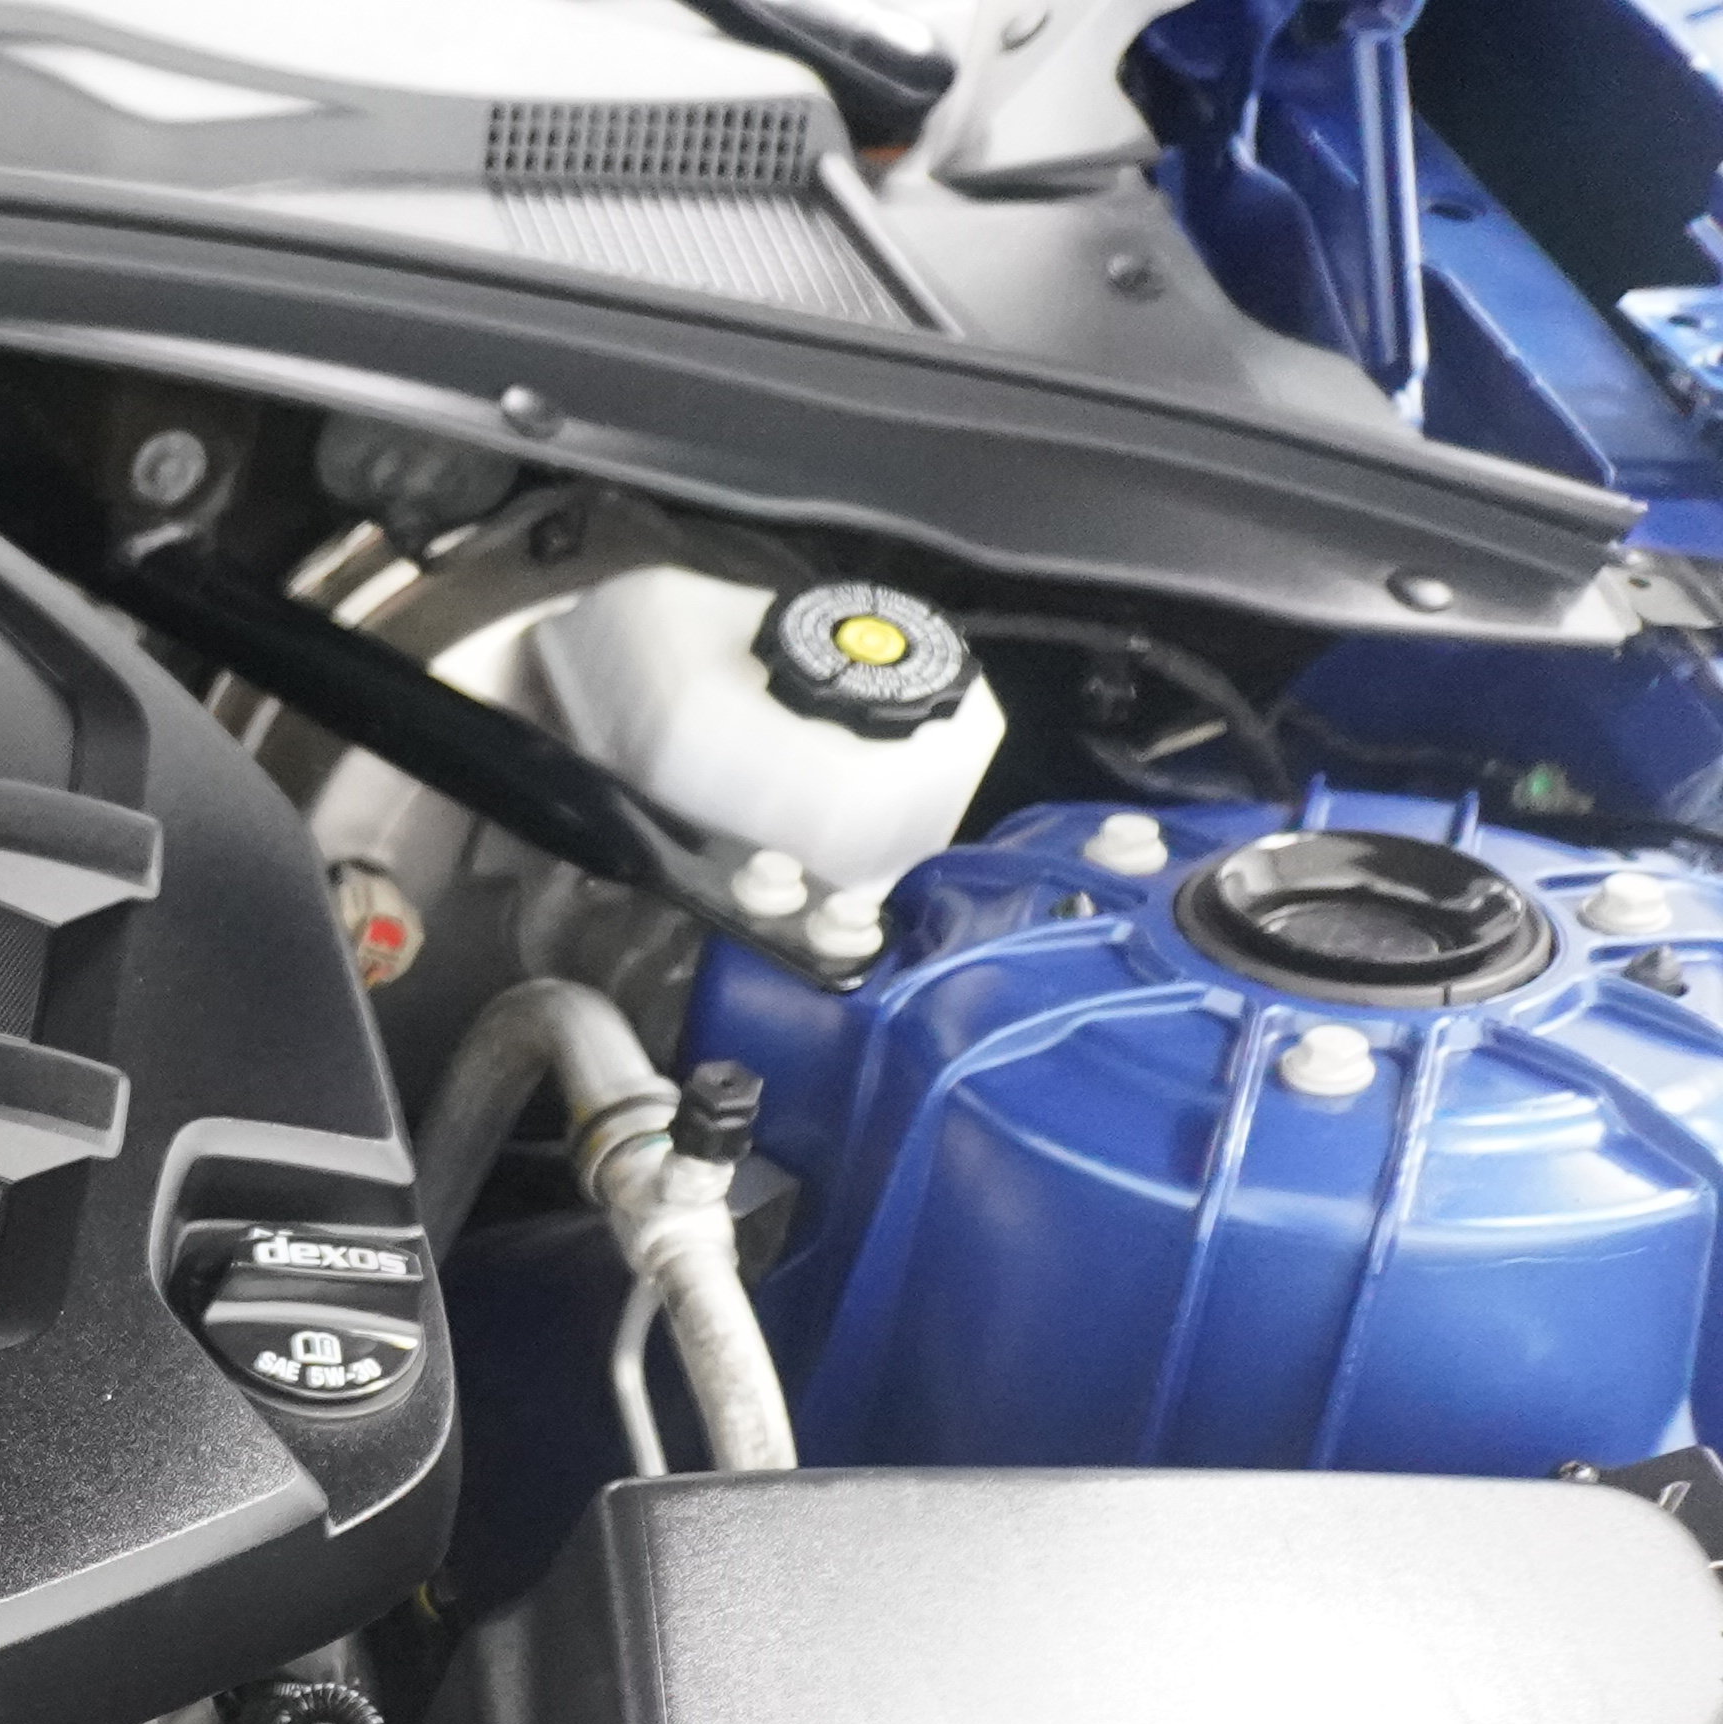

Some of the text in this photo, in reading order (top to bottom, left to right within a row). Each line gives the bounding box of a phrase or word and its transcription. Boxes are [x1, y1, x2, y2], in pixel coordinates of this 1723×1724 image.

[253, 1236, 407, 1275] dexos
[256, 1351, 382, 1388] SAE 5W-30
